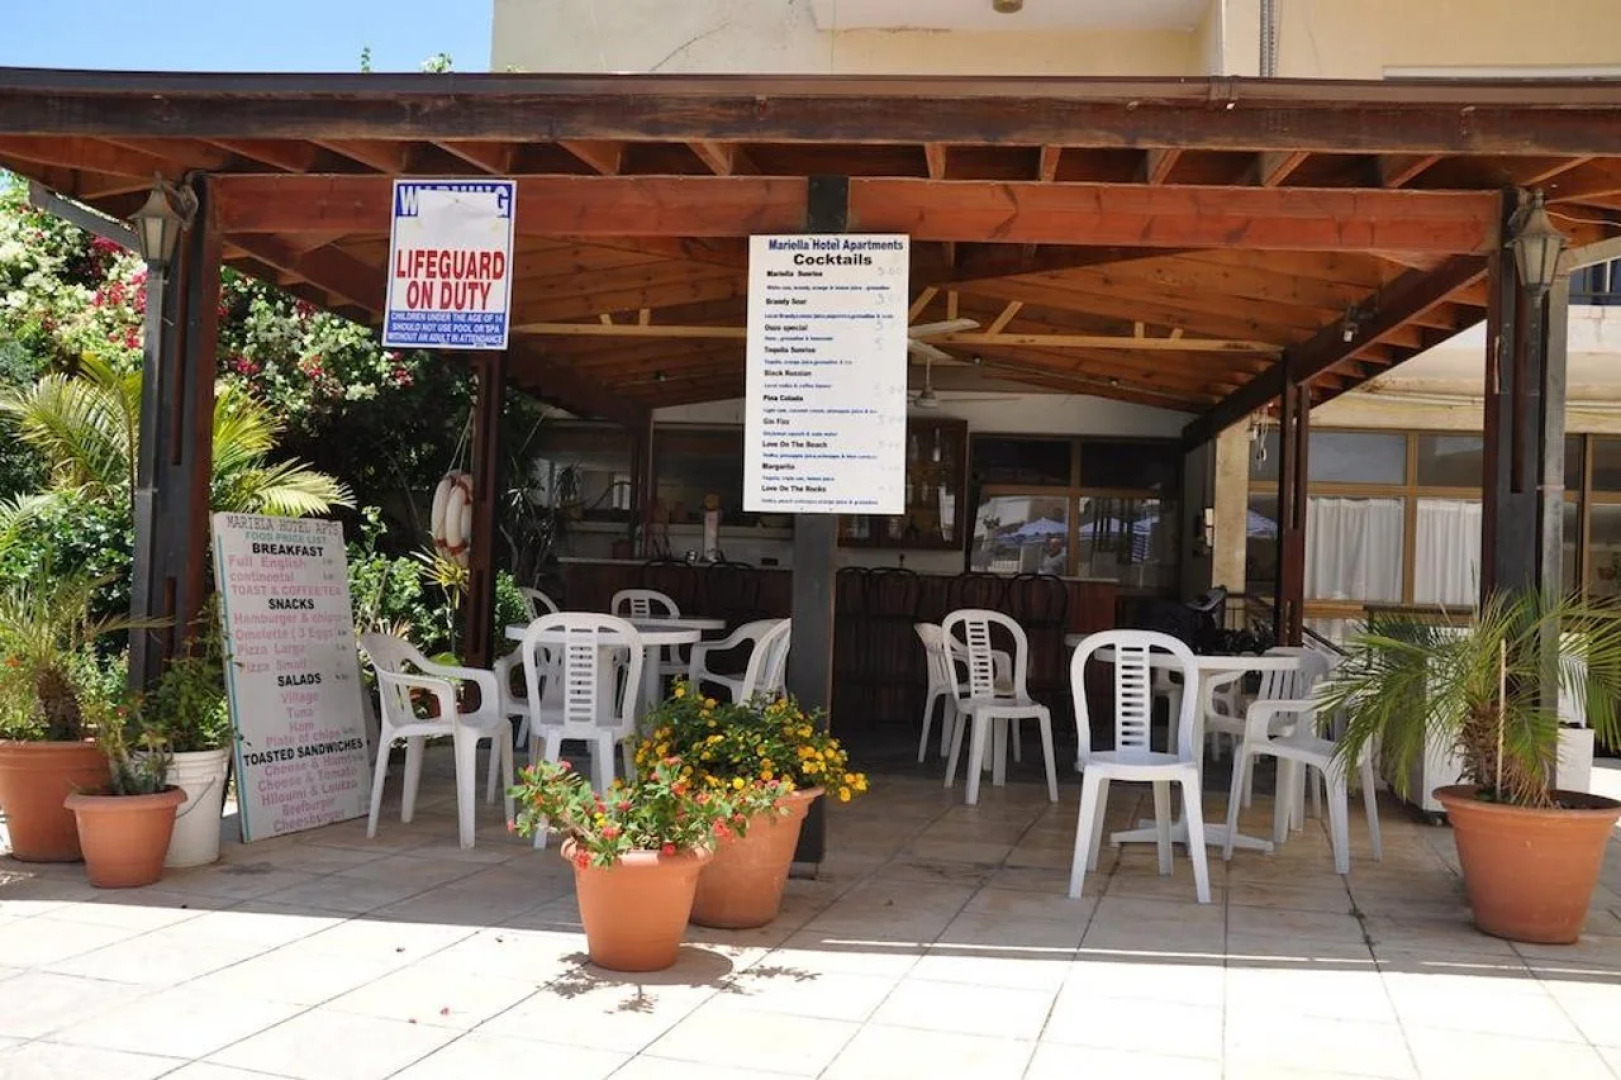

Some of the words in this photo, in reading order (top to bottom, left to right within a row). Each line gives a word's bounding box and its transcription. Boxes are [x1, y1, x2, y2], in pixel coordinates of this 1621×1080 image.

[769, 239, 810, 250] Mariella
[812, 239, 840, 250] Hotel
[842, 239, 904, 252] Apartments
[396, 250, 505, 280] LIFEGUARD
[793, 254, 872, 266] Cocktails
[406, 281, 434, 309] ON
[440, 282, 492, 311] DUTY
[391, 312, 426, 320] CHILDREN
[427, 313, 451, 321] UNDER
[452, 313, 466, 321] THE
[468, 313, 482, 322] AGE
[483, 314, 494, 322] OF
[392, 322, 419, 331] SHOULD
[422, 323, 436, 331] NOT
[437, 323, 452, 332] USE
[452, 324, 472, 332] POOL
[473, 324, 485, 332] OR
[486, 324, 500, 333] SPA
[783, 324, 808, 332] special
[388, 332, 418, 341] WITHOUT
[429, 333, 450, 342] ADULT
[460, 334, 503, 344] ATTENDANCE
[245, 532, 273, 540] FOOD
[276, 533, 304, 542] PRICE
[306, 535, 326, 544] LIST
[252, 542, 324, 556] BREAKFAST
[228, 556, 252, 566] Full
[261, 556, 304, 570] English
[230, 572, 293, 582] continental
[232, 585, 266, 596] TOAST
[271, 586, 278, 596] &
[268, 598, 315, 610] SNACKS
[234, 612, 297, 625] Hamburger
[301, 612, 309, 620] &
[236, 629, 288, 640] Omelette
[237, 644, 267, 656] Pizza
[274, 643, 304, 656] Large
[241, 660, 270, 672] izza
[276, 660, 306, 671] Small
[278, 673, 322, 687] SALADS
[281, 690, 318, 704] Village
[286, 707, 314, 718] Tuna
[289, 722, 314, 732] Ham
[266, 735, 293, 746] Plate
[300, 732, 310, 740] of
[313, 728, 340, 740] chips
[243, 748, 295, 766] TOASTED
[298, 738, 363, 758] SANDWICHES
[264, 762, 306, 776] Cheese
[312, 758, 319, 768] &
[258, 778, 300, 792] Cheese
[306, 774, 314, 782] &
[320, 768, 357, 780] Tomato
[311, 786, 318, 796] &
[282, 798, 334, 816] Beefburger
